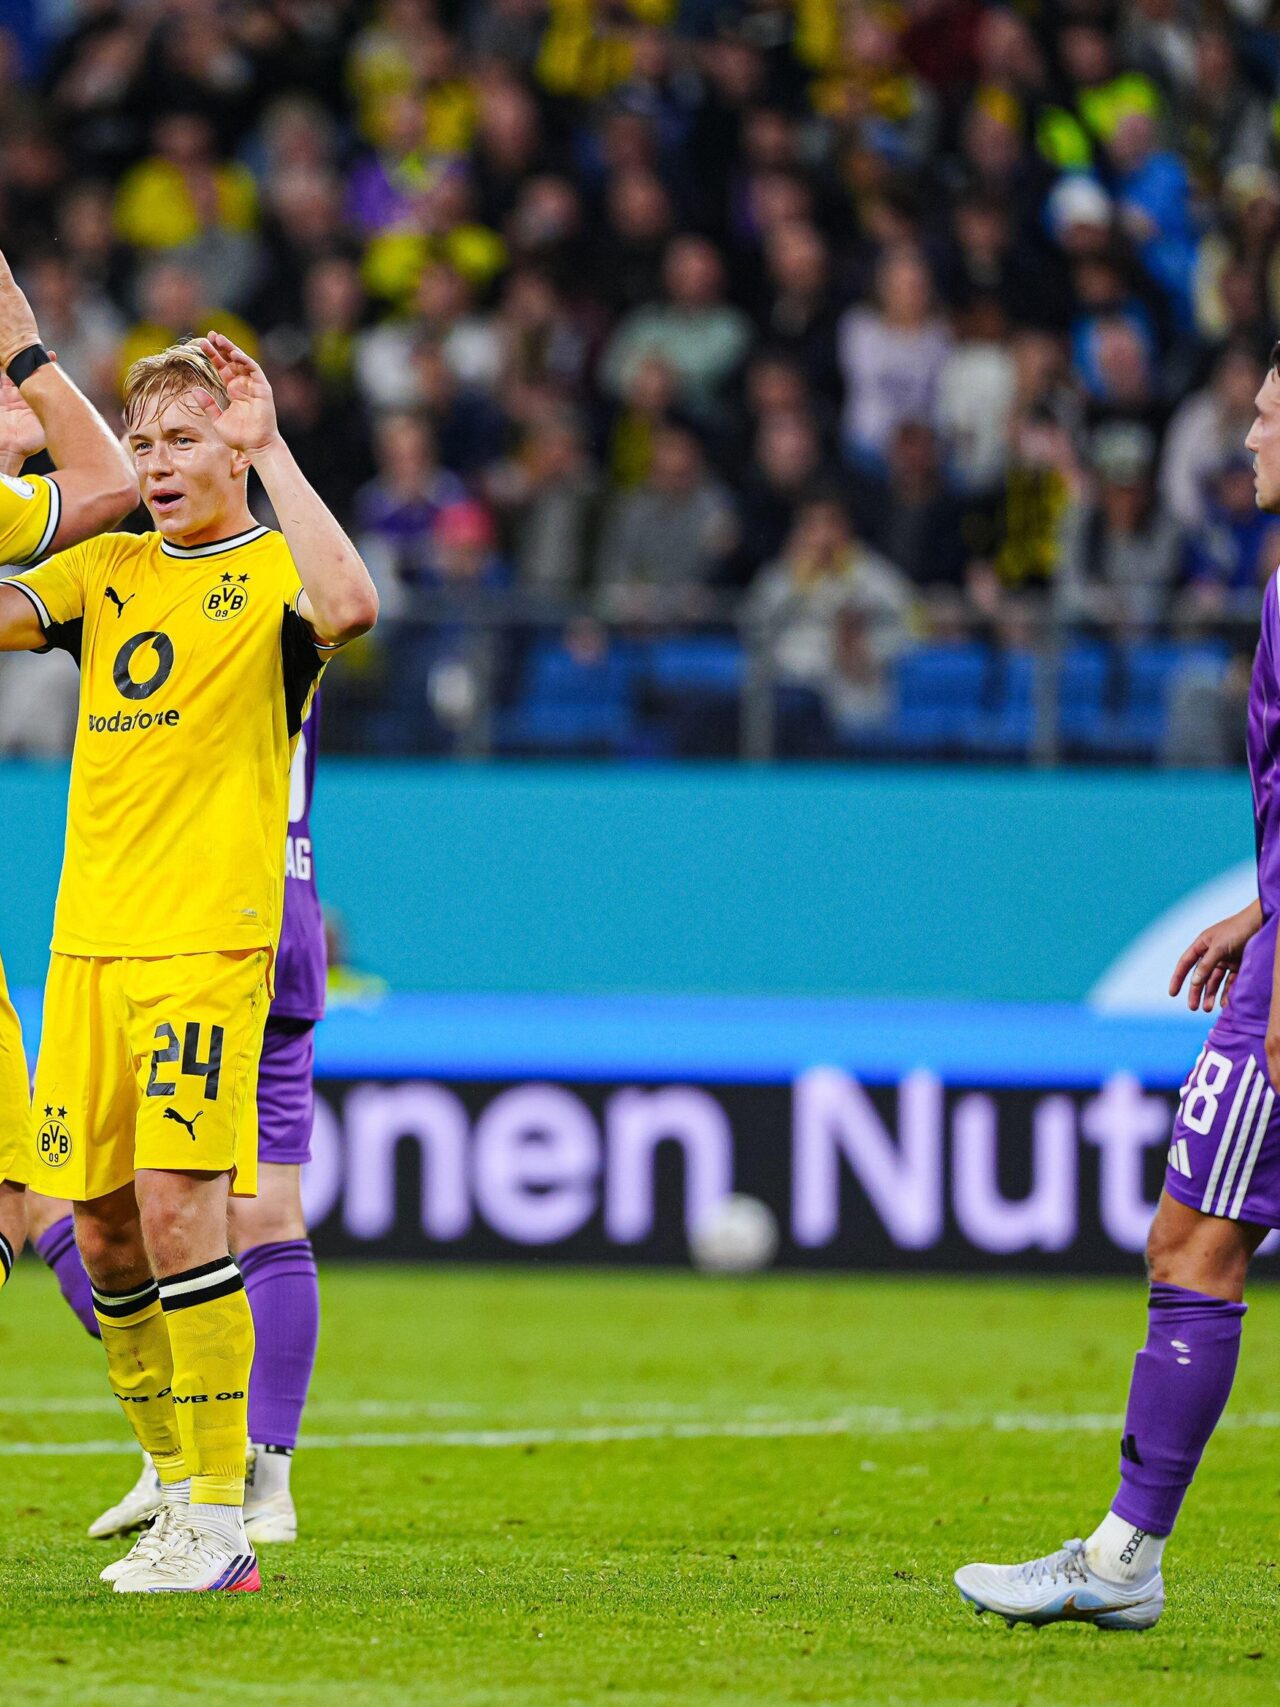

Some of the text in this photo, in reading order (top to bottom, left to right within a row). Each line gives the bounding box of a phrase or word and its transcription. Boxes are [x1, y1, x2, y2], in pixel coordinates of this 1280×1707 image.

[208, 587, 244, 610] BVB
[215, 609, 229, 618] 09
[146, 1021, 225, 1101] 24
[1178, 1046, 1234, 1136] 8
[40, 1124, 69, 1153] BVB
[48, 1152, 60, 1163] 09
